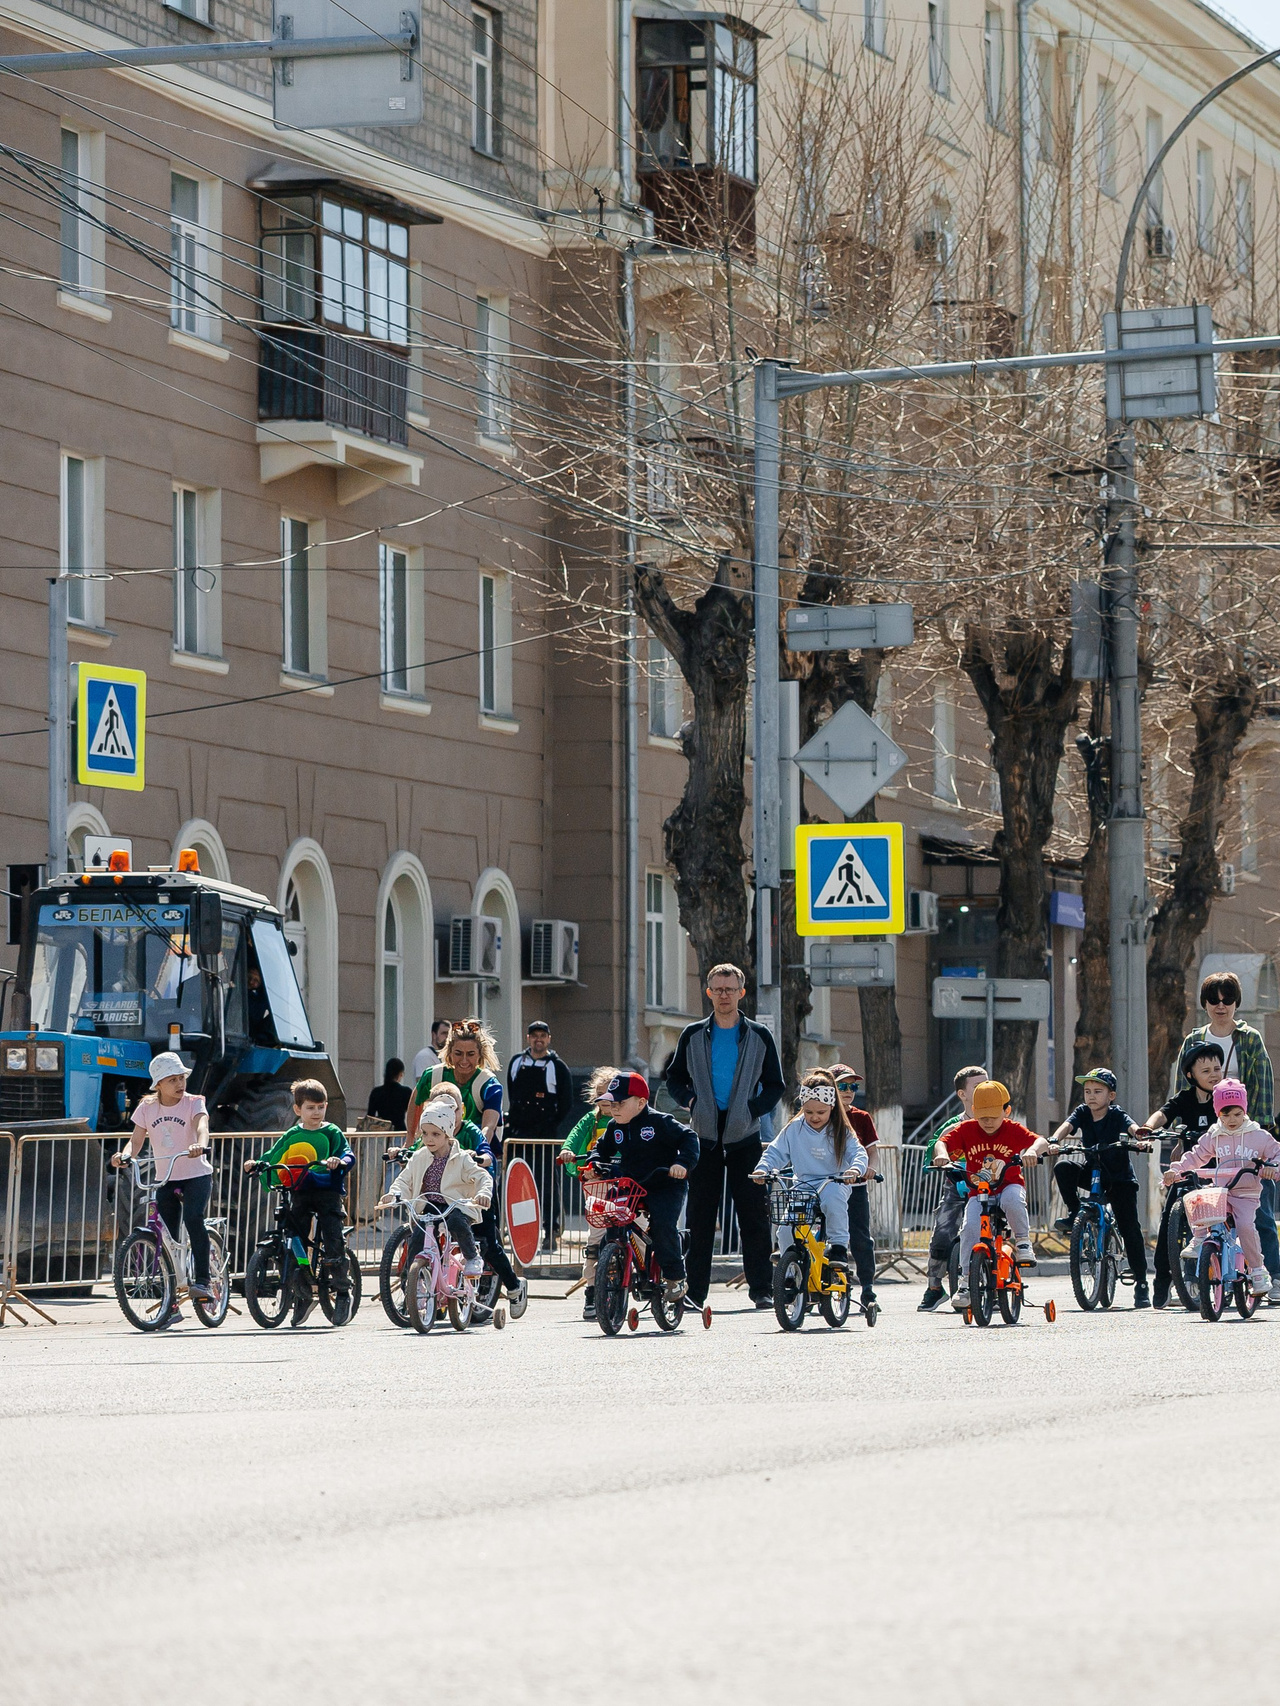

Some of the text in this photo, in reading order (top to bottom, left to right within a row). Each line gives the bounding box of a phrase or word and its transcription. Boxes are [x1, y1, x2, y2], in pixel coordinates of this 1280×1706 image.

[78, 908, 157, 922] БЕЛАРУС
[99, 1000, 139, 1009] BELARUS
[88, 1012, 129, 1023] ELARUS
[151, 1117, 163, 1128] BEST
[173, 1117, 186, 1127] EVER
[967, 1143, 1013, 1161] CHILL VIBE
